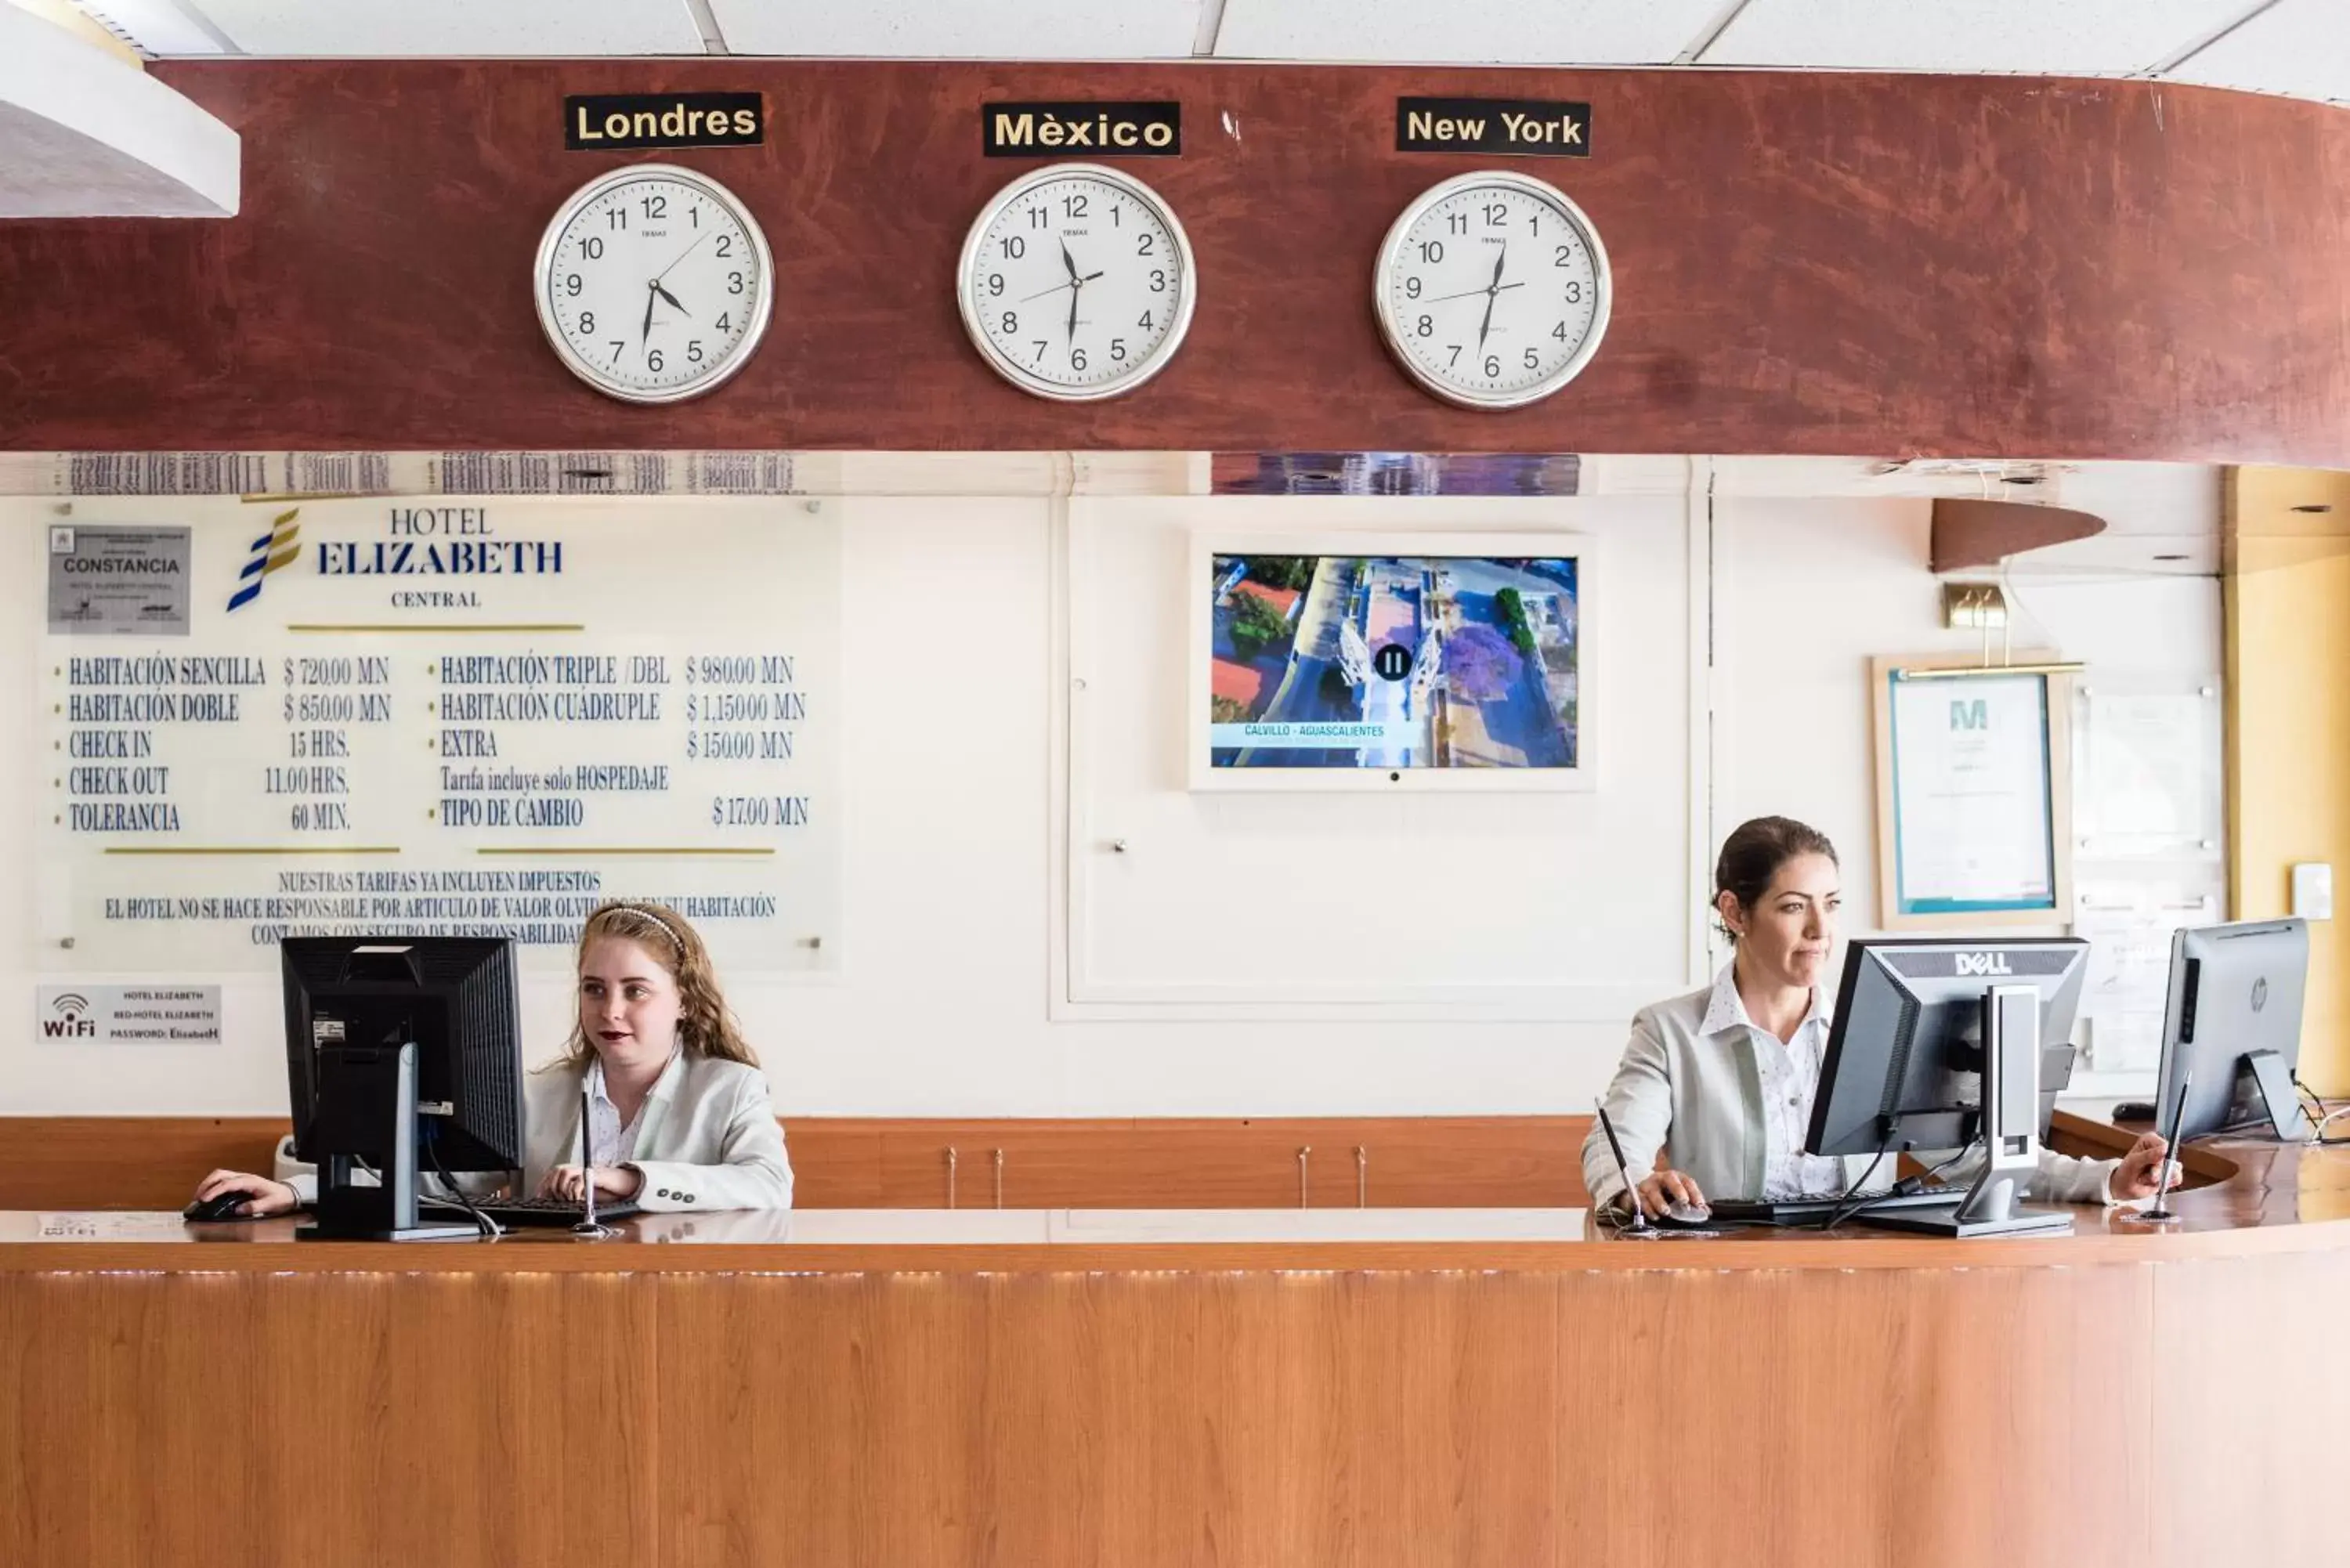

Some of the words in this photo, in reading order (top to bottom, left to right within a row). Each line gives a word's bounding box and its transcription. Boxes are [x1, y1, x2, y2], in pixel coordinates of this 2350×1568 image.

[578, 103, 757, 139] Londres
[996, 114, 1173, 146] Mèxico
[1408, 111, 1486, 141] New
[1501, 113, 1582, 144] York
[641, 196, 666, 219] 12
[689, 207, 698, 228] 1
[1028, 207, 1047, 228] 11
[1063, 196, 1087, 218] 12
[1110, 205, 1119, 227] 1
[1482, 204, 1507, 226] 12
[606, 208, 626, 229] 11
[1448, 214, 1467, 235] 11
[1529, 215, 1538, 237] 1
[578, 237, 604, 259] 10
[716, 236, 732, 258] 2
[1000, 237, 1025, 258] 10
[1137, 234, 1153, 256] 2
[1419, 241, 1444, 263] 10
[1555, 246, 1570, 267] 2
[566, 274, 582, 297] 9
[728, 272, 743, 294] 3
[989, 274, 1004, 297] 9
[1149, 270, 1166, 292] 3
[1406, 277, 1422, 299] 9
[1566, 282, 1581, 304] 3
[579, 312, 595, 334] 8
[715, 312, 732, 334] 4
[1002, 312, 1018, 334] 8
[1137, 310, 1154, 332] 4
[1417, 315, 1433, 338] 8
[1552, 321, 1567, 342] 4
[609, 341, 625, 363] 7
[688, 340, 703, 363] 5
[1032, 341, 1048, 362] 7
[1072, 349, 1087, 371] 6
[1111, 339, 1126, 361] 5
[1448, 345, 1462, 367] 7
[1524, 348, 1539, 370] 5
[648, 350, 663, 373] 6
[1484, 356, 1500, 378] 6
[390, 508, 493, 535] HOTEL
[64, 558, 179, 574] CONSTANCIA
[317, 542, 562, 575] ELIZABETH
[391, 591, 482, 608] CENTRAL
[70, 651, 176, 685] HABITACIÓN
[181, 657, 266, 685] SENCILLA
[284, 656, 294, 687] $
[358, 656, 389, 685] MN
[441, 649, 549, 684] HABITACIÓN
[554, 656, 616, 684] TRIPLE
[686, 656, 696, 685] $
[761, 656, 794, 684] MN
[70, 687, 176, 721] HABITACIÓN
[181, 693, 239, 721] DOBLE
[284, 693, 294, 722] $
[360, 693, 391, 721] MN
[441, 686, 549, 721] HABITACIÓN
[554, 685, 660, 721] CUÁDRUPLE
[687, 693, 696, 722] $
[774, 692, 807, 721] MN
[1245, 724, 1290, 735] CALVILLO
[1300, 725, 1384, 736] AGUASCALIENTES
[70, 730, 128, 758] CHECK
[134, 730, 151, 758] IN
[291, 732, 306, 758] 15
[311, 729, 350, 757] HRS.
[441, 729, 497, 757] EXTRA
[687, 730, 696, 759] $
[761, 731, 793, 759] MN
[70, 767, 128, 794] CHECK
[133, 767, 168, 794] OUT
[441, 766, 483, 791] Tarifa
[488, 765, 540, 797] incluye
[544, 766, 572, 791] solo
[576, 765, 668, 791] HOSPEDAJE
[70, 803, 179, 831] TOLERANCIA
[292, 804, 308, 830] 60
[313, 802, 350, 830] MIN.
[441, 799, 482, 826] TIPO
[487, 799, 510, 826] DE
[515, 798, 584, 826] CAMBIO
[713, 797, 723, 826] $
[775, 797, 809, 825] MN
[279, 872, 352, 892] NUESTRAS
[357, 871, 417, 891] TARIFAS
[421, 871, 438, 891] YA
[443, 871, 515, 891] INCLUYEN
[519, 870, 602, 891] IMPUESTOS
[106, 898, 125, 919] EL
[128, 898, 175, 919] HOTEL
[179, 898, 198, 919] NO
[201, 898, 219, 919] SE
[224, 898, 262, 918] HACE
[266, 898, 368, 918] RESPONSABLE
[372, 898, 401, 918] POR
[404, 897, 477, 918] ARTICULO
[482, 897, 501, 918] DE
[504, 897, 552, 918] VALOR
[687, 891, 776, 917] HABITACIÓN
[1955, 952, 2012, 976] DELL
[124, 992, 152, 1001] HOTEL
[155, 992, 204, 1001] ELIZABETH
[44, 1013, 95, 1038] WiFi
[165, 1010, 213, 1020] ELIZABETH
